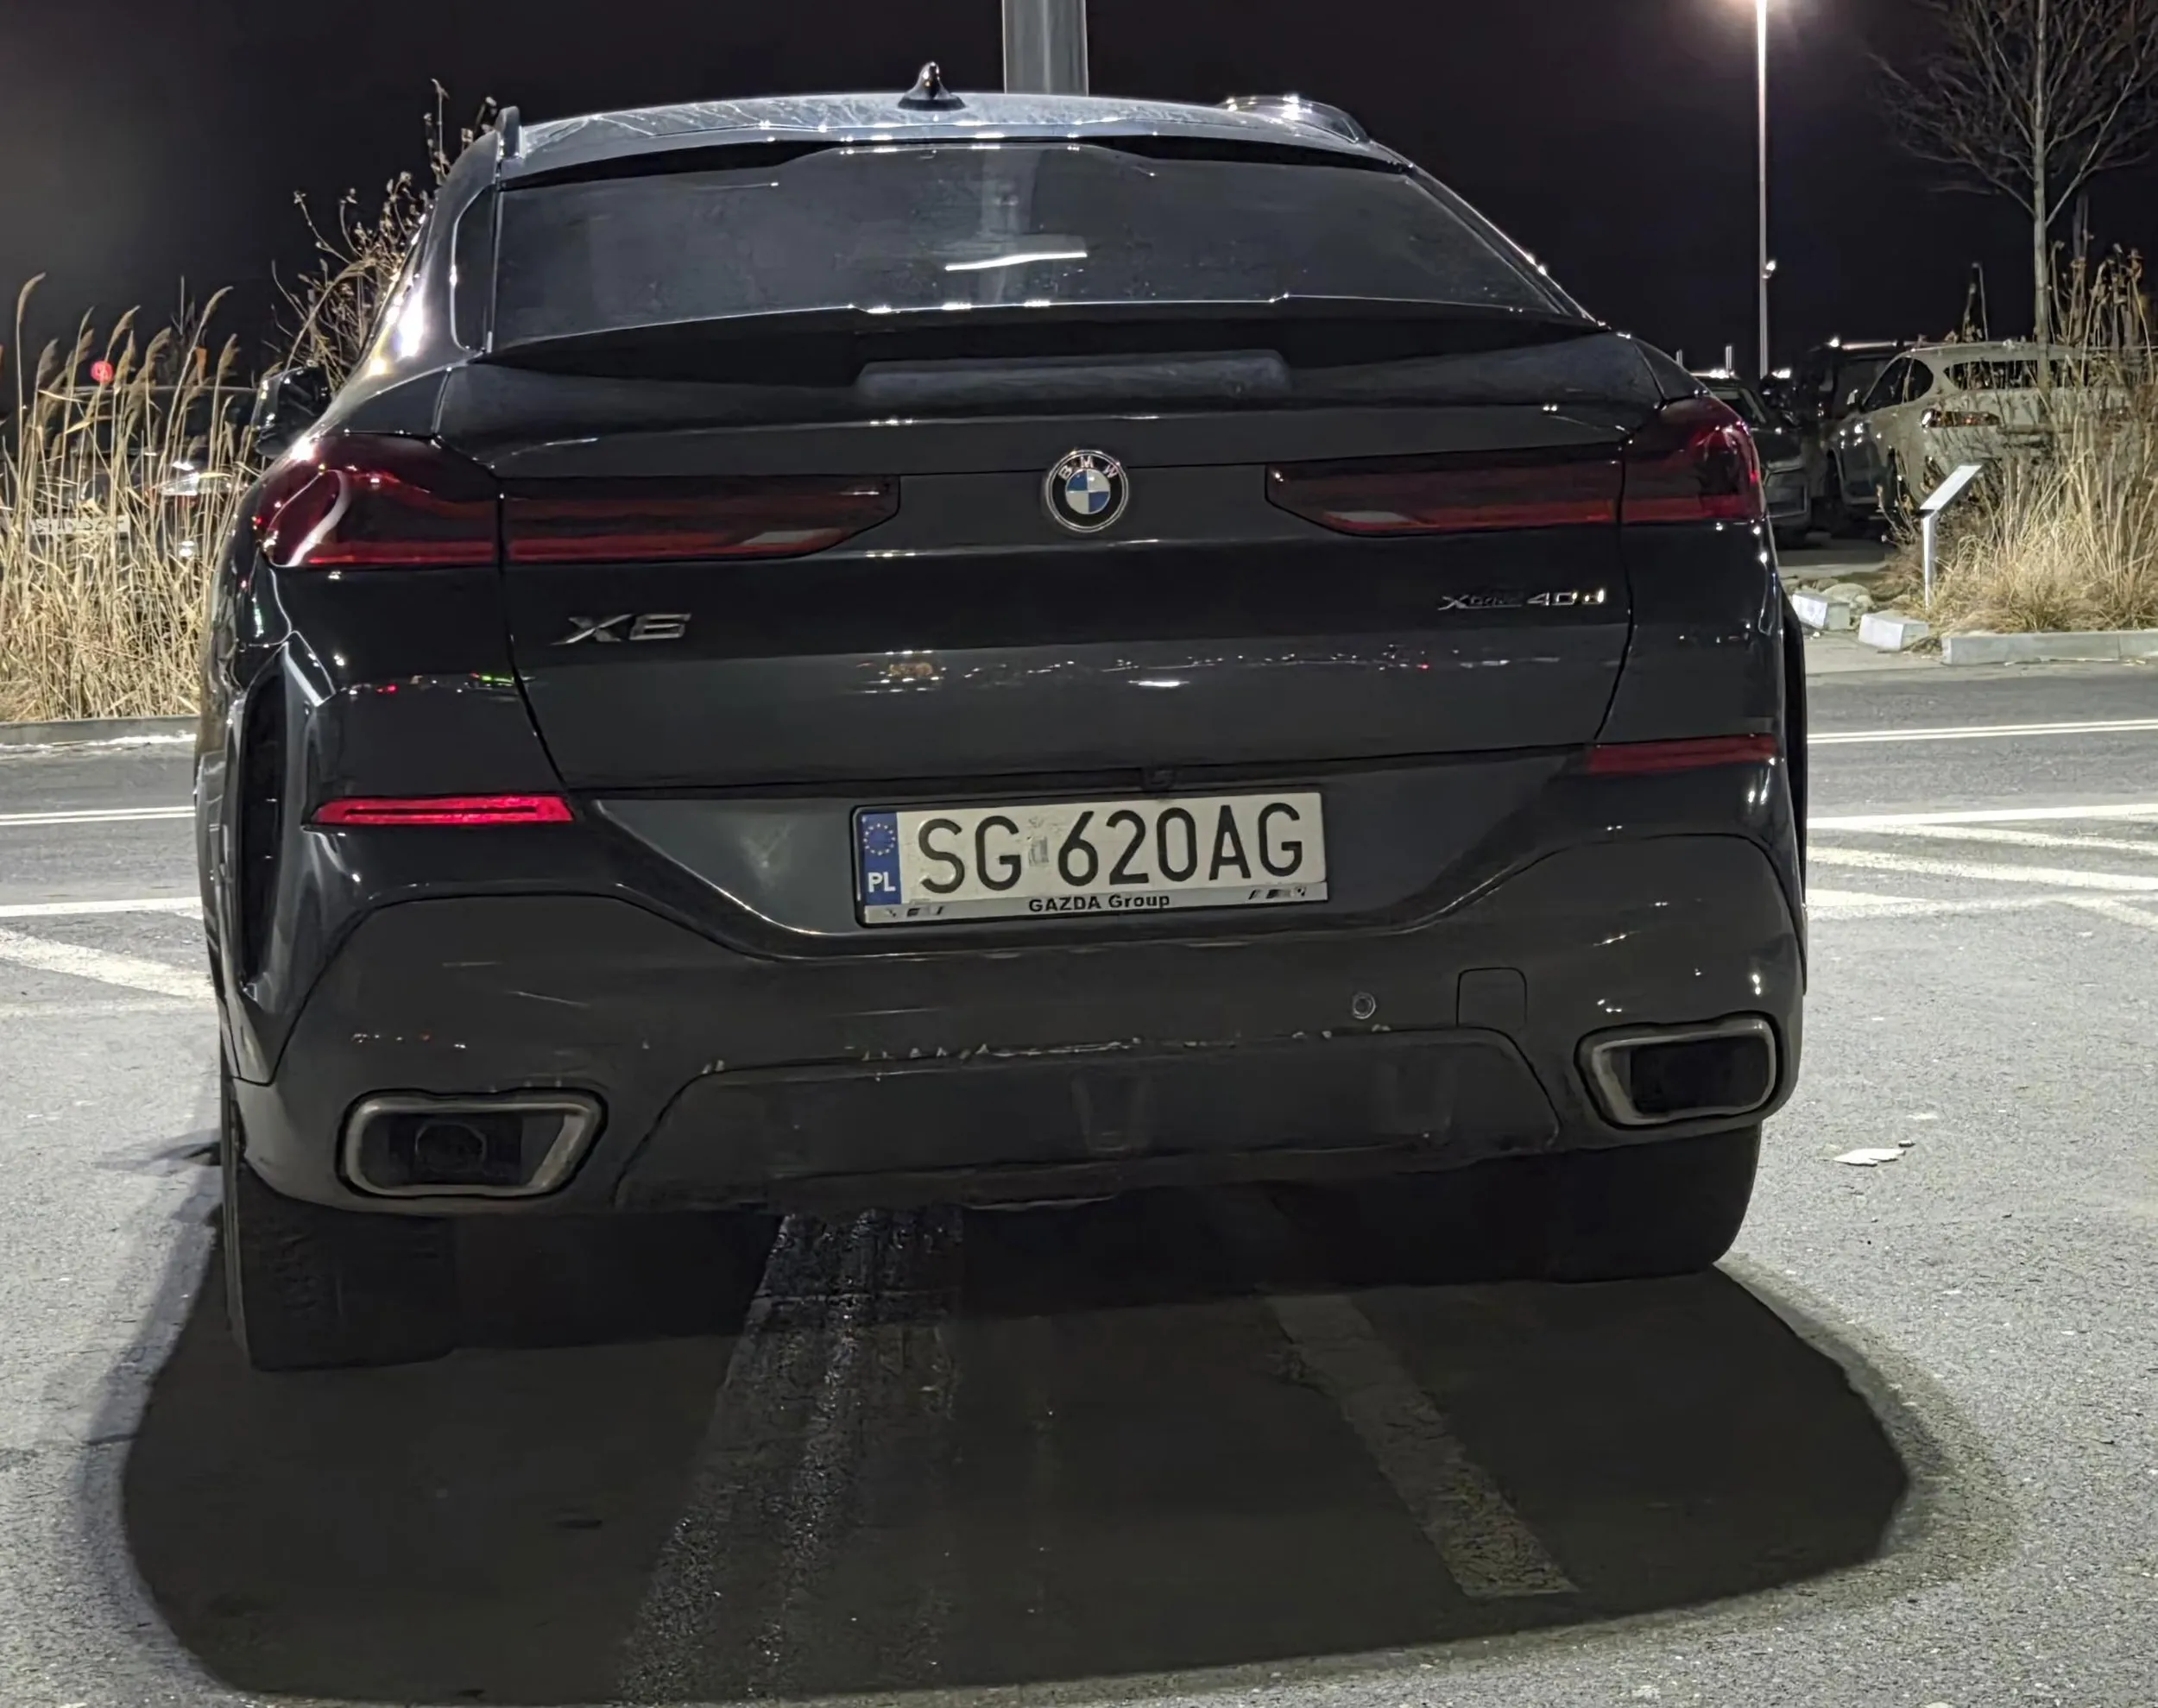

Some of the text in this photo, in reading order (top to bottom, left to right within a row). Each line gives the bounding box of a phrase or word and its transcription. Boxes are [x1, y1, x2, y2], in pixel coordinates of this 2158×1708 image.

[1058, 455, 1120, 480] BMW
[551, 614, 691, 646] X6
[918, 802, 1303, 894] SG 620AG
[868, 872, 896, 892] PL
[1028, 892, 1170, 913] GAZDA Group
